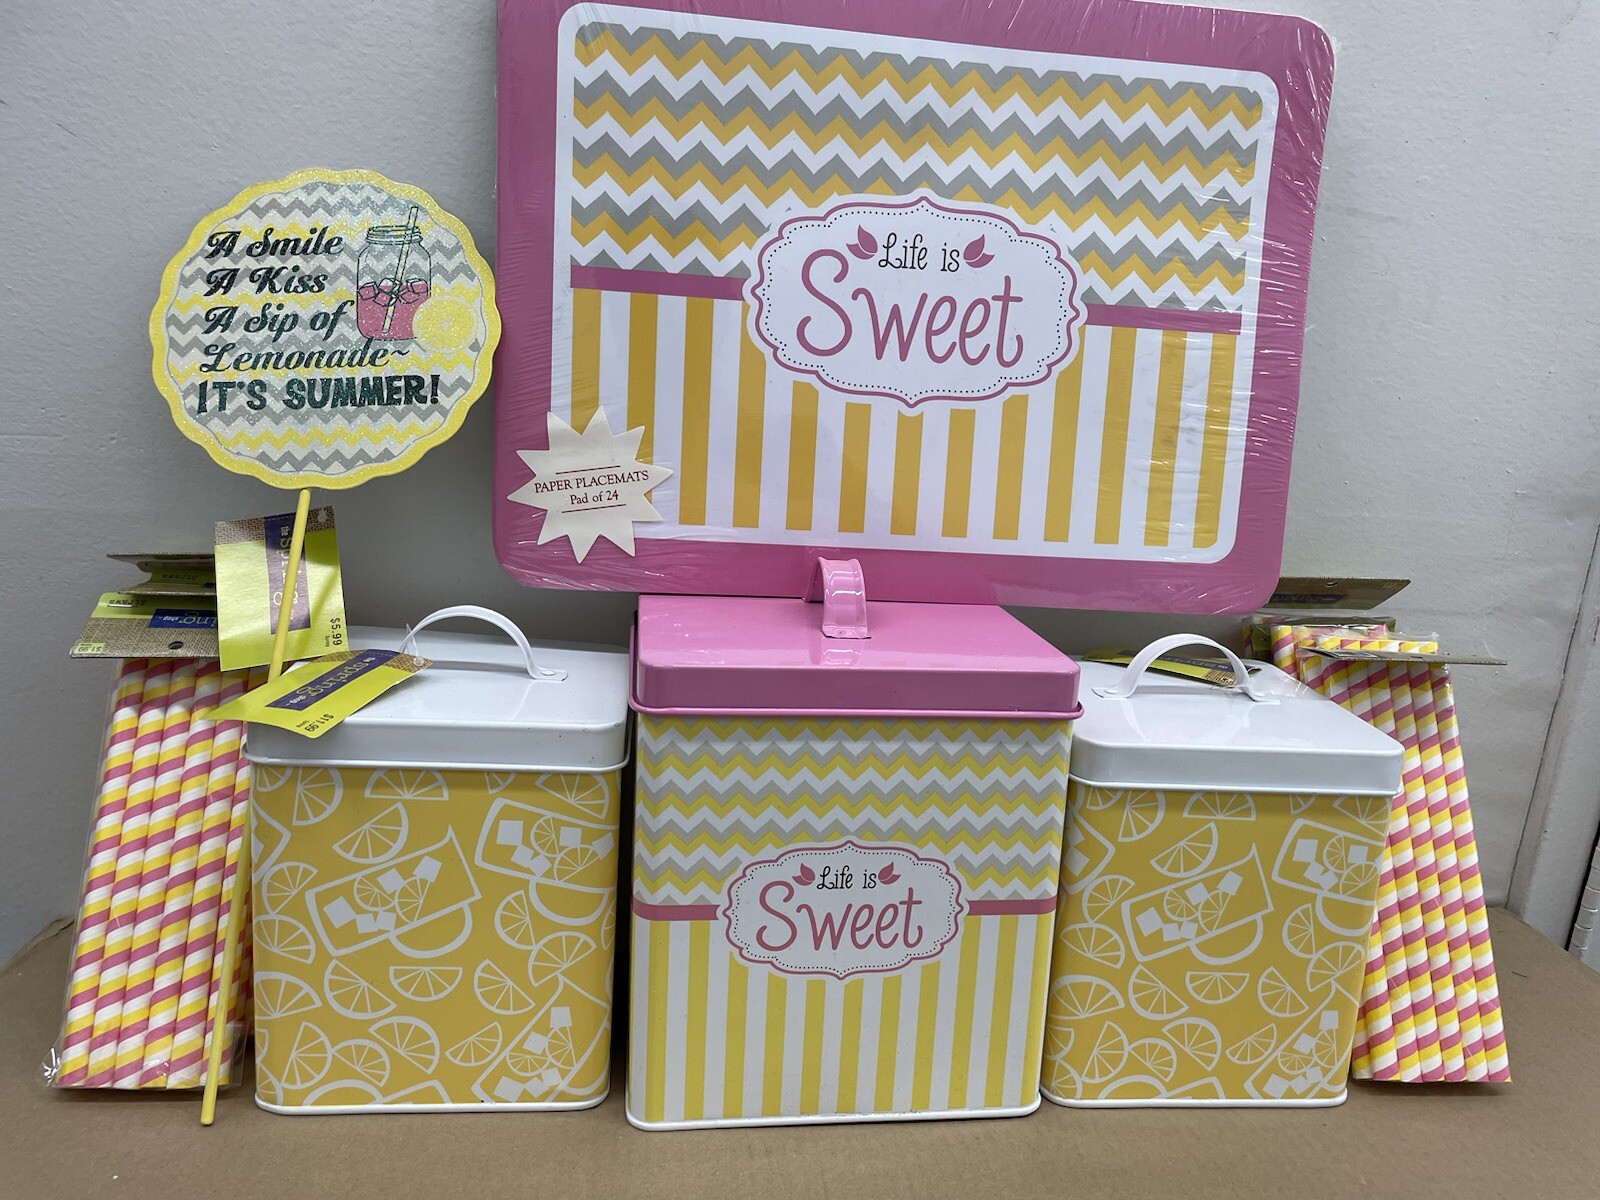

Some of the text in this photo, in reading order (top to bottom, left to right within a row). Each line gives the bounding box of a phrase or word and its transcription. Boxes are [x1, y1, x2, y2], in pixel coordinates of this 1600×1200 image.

[205, 226, 344, 259] A Smile
[878, 232, 960, 272] Life is
[203, 265, 329, 297] A Kiss
[202, 300, 355, 342] A Sip of
[797, 249, 1023, 368] Sweet
[197, 374, 440, 414] IT'S SUMMER!
[534, 470, 650, 494] PAPER PLACEMATS
[570, 490, 619, 505] Pad of 24
[330, 617, 342, 646] $5.99
[816, 865, 878, 890] Life is
[756, 880, 923, 952] Sweet
